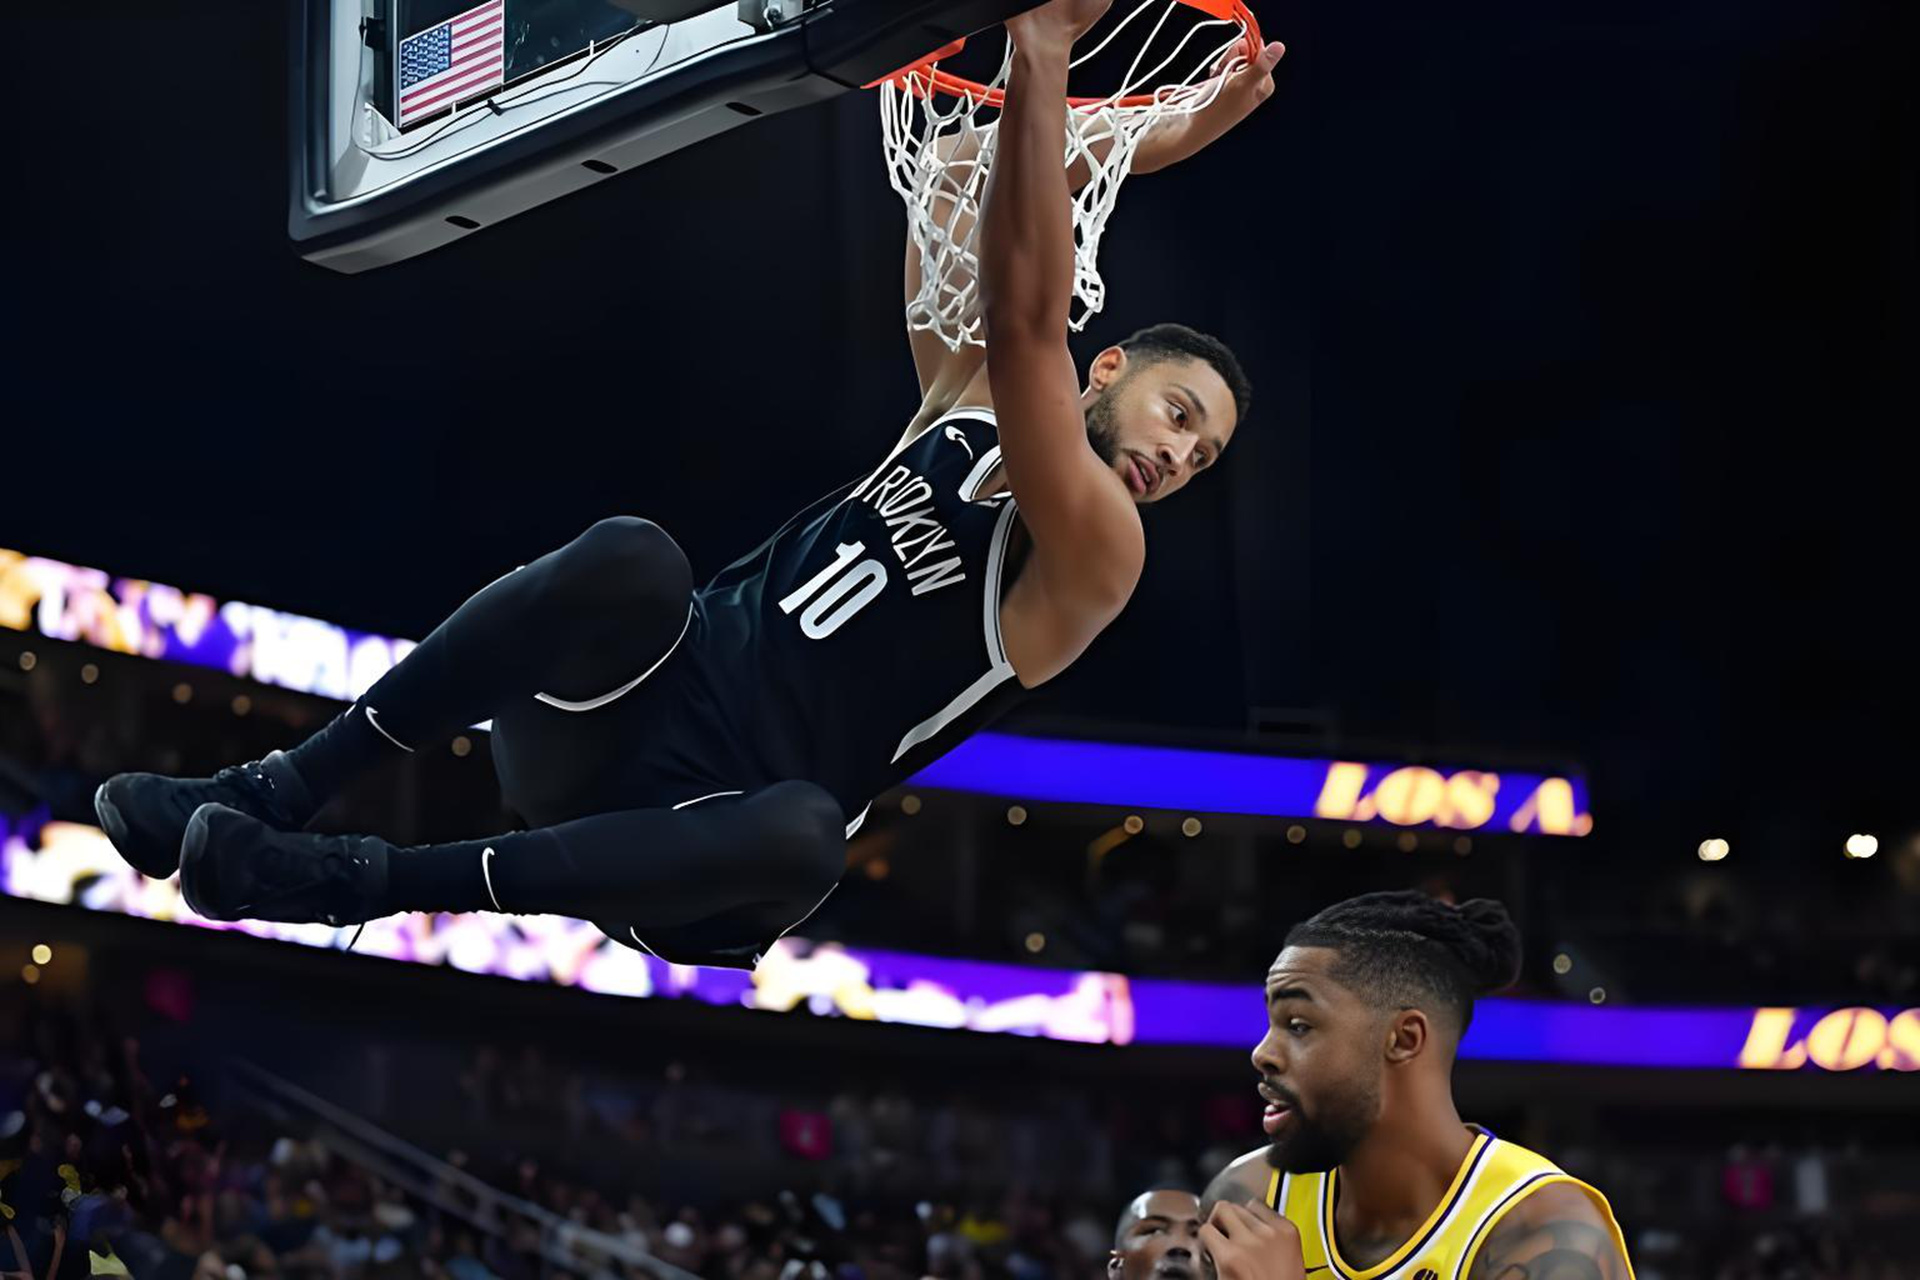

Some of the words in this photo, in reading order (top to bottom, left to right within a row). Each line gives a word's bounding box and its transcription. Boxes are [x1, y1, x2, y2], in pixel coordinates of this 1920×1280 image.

[852, 465, 966, 596] ROKLYN
[778, 540, 888, 640] 10
[1315, 761, 1500, 829] LOS
